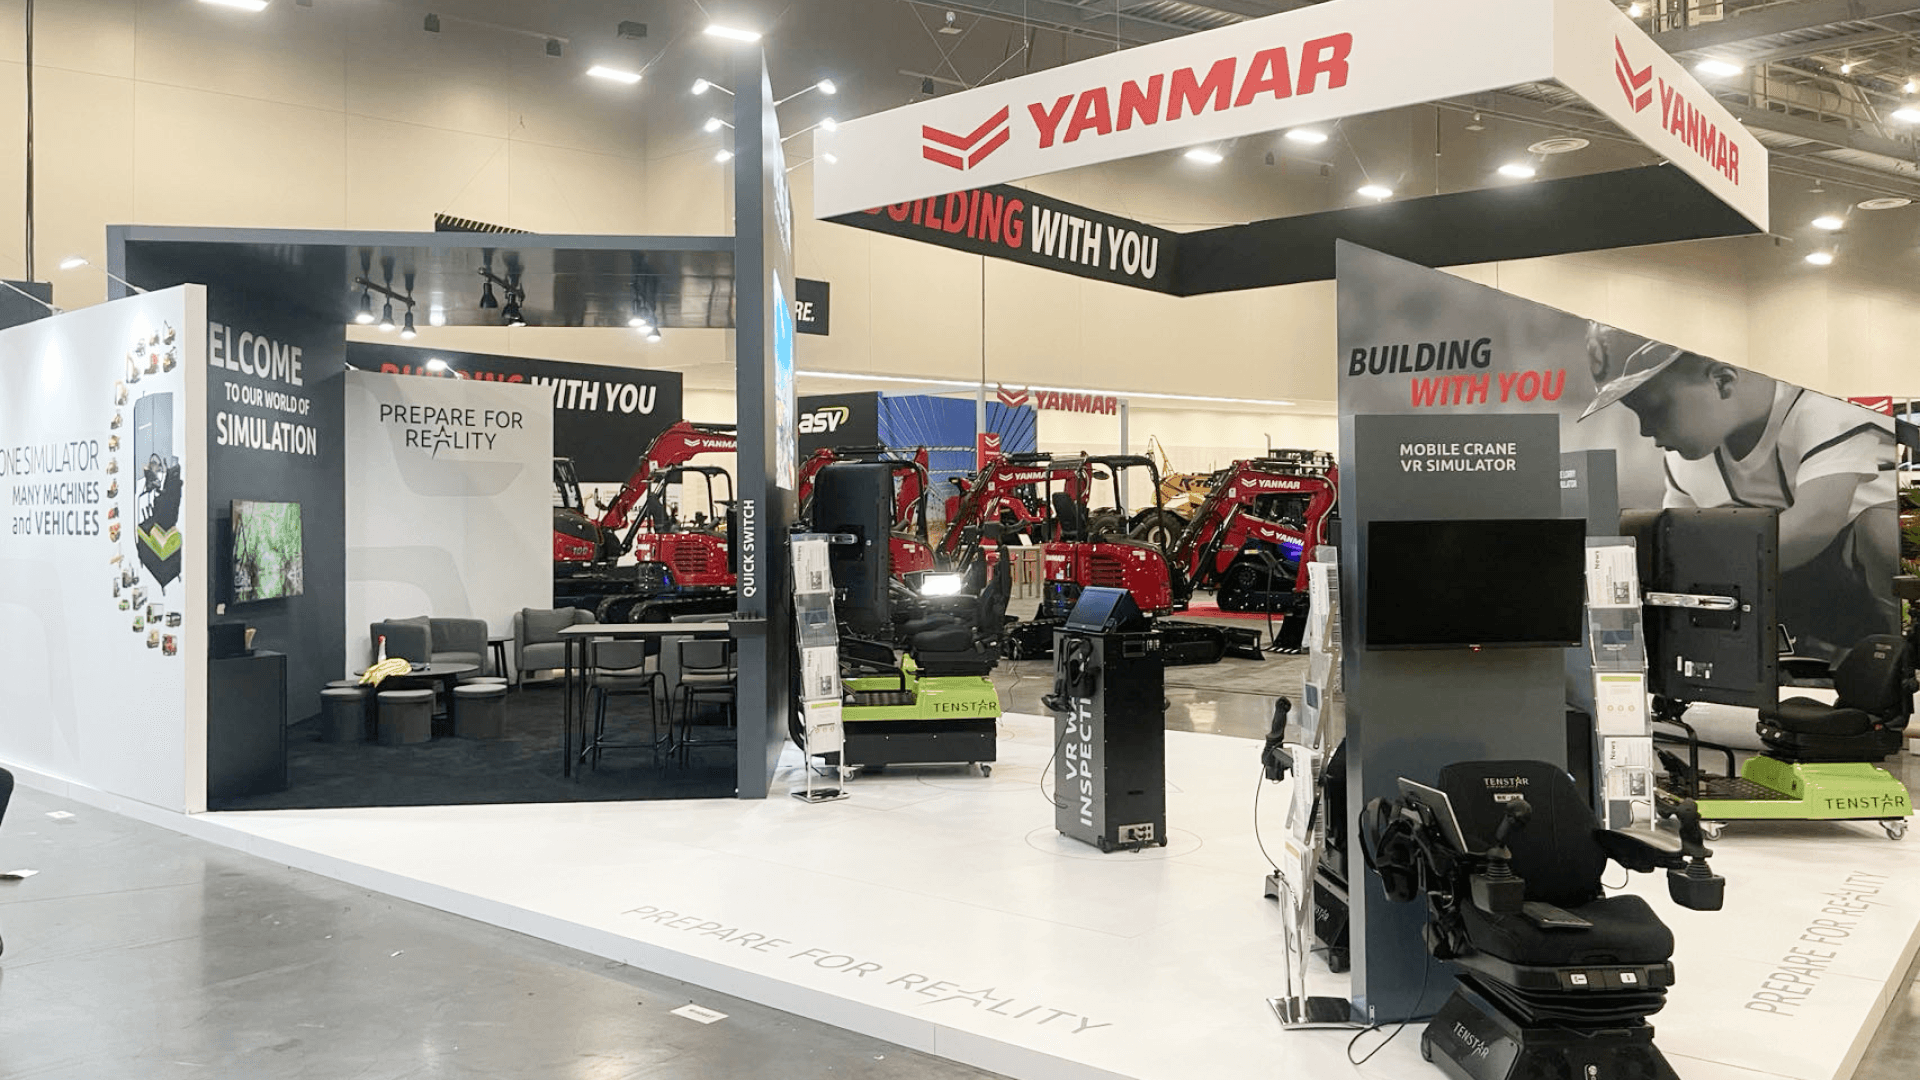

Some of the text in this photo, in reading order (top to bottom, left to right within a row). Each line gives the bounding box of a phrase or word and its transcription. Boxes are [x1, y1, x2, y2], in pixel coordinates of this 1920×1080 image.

[1028, 32, 1352, 149] YANMAR
[1659, 77, 1739, 186] YANMAR
[864, 190, 1159, 279] UILDING WITH YOU
[209, 321, 303, 387] ELCOME
[1349, 338, 1492, 377] BUILDING
[224, 381, 310, 416] TO OUR WORLD OF
[605, 382, 657, 414] YOU
[1035, 390, 1117, 415] YANMAR
[1411, 368, 1567, 408] WITH YOU
[216, 411, 317, 456] SIMULATION
[380, 404, 523, 429] PREPARE FOR
[0, 440, 99, 476] ONE SIMULATOR
[405, 425, 496, 459] REALITY
[1400, 443, 1517, 456] MOBILE CRANE
[1401, 459, 1516, 472] VR SIMULATOR
[12, 481, 99, 505] MANY MACHINES
[1259, 480, 1300, 489] YANMAR
[12, 508, 99, 535] and VEHICLES
[743, 499, 757, 597] QUICK SWITCH
[933, 699, 997, 716] TENSTAR
[1066, 743, 1077, 781] VR
[1483, 776, 1530, 787] TENSTAR
[1824, 793, 1905, 813] TENSTAR
[1744, 870, 1892, 1017] PREPARE FOR REALITY
[621, 905, 1113, 1035] PREPARE FOR REALITY
[1453, 1021, 1490, 1060] TENSTAR
